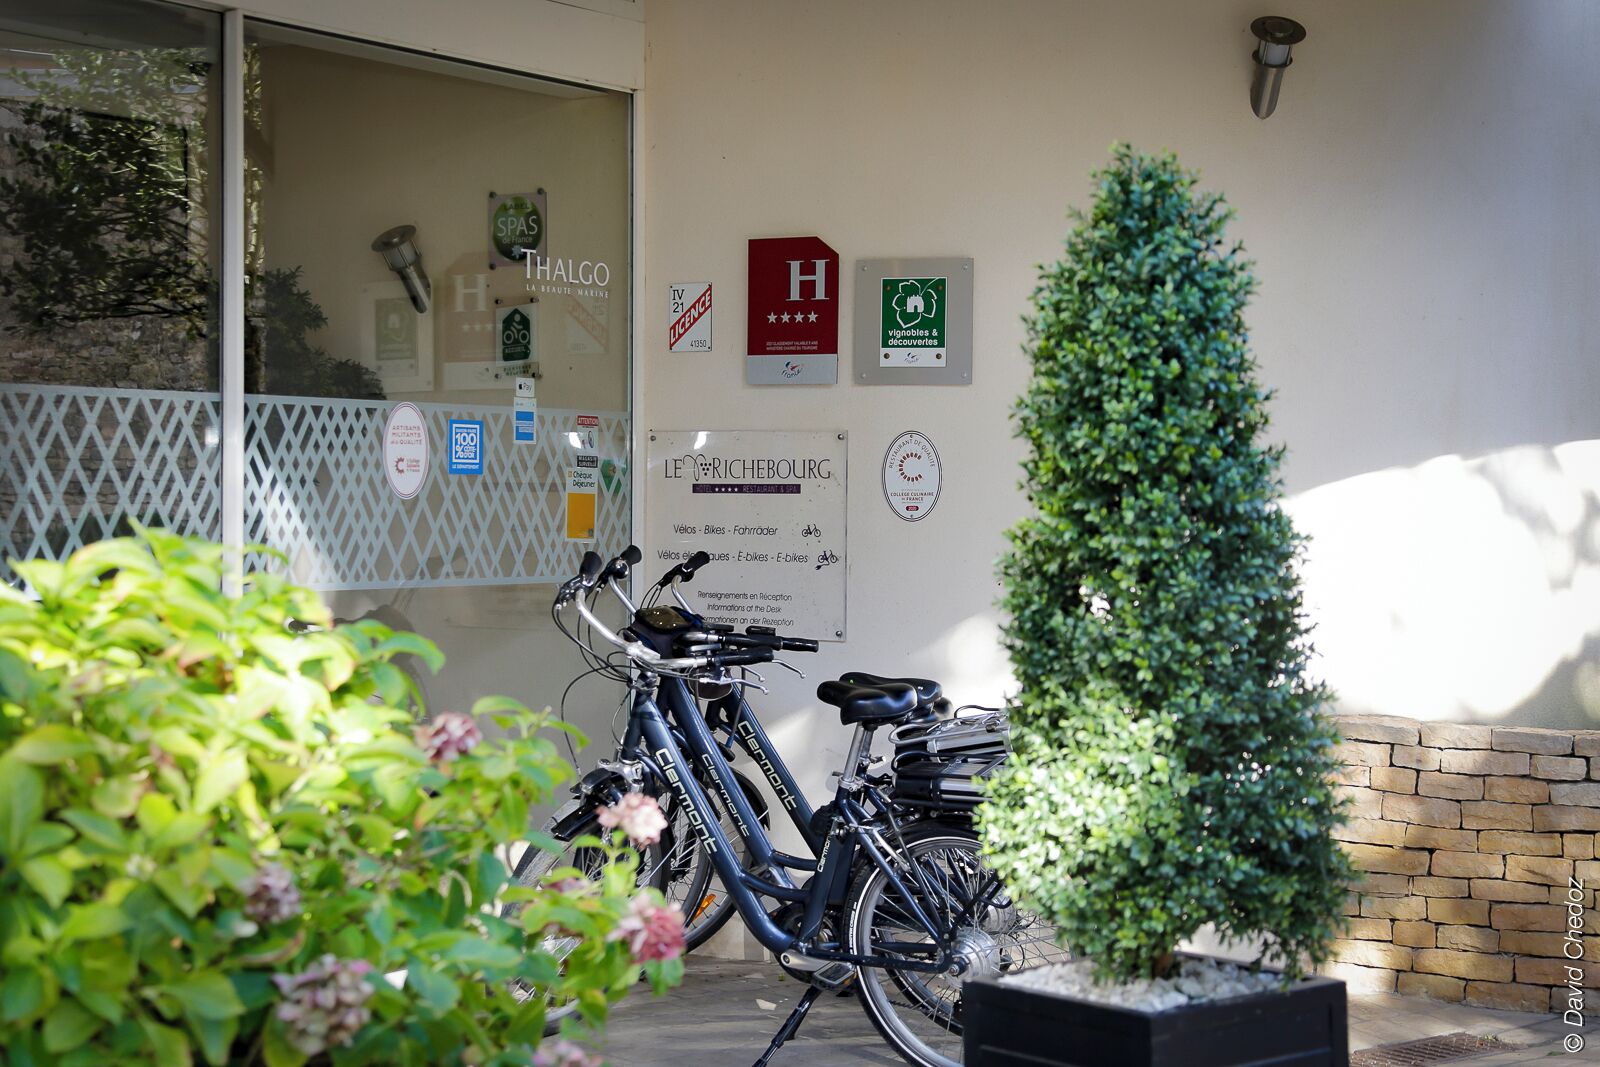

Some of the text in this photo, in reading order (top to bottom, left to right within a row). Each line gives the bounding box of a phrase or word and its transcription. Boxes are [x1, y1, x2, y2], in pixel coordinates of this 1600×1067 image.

[497, 215, 538, 236] SPAS
[521, 248, 609, 286] THALGO
[785, 259, 830, 301] H
[541, 285, 572, 295] BEAUTE
[577, 289, 609, 299] MARINE
[672, 289, 685, 300] IV
[673, 302, 684, 313] 21
[671, 289, 711, 345] LICENCE
[888, 329, 929, 338] vignobles
[888, 338, 938, 346] découvertes
[523, 382, 532, 393] Pay
[578, 417, 599, 425] ATTENTION
[455, 433, 476, 445] 100
[889, 439, 913, 469] RESTAURANT
[914, 439, 921, 447] DE
[664, 457, 831, 479] LE RICHEBOURG
[573, 470, 592, 480] Chèque
[573, 479, 595, 488] Déjeuner
[673, 524, 696, 535] Vélos
[704, 525, 725, 535] Bikes
[733, 525, 778, 536] Fahrräder
[657, 549, 680, 560] Vélos
[737, 551, 768, 562] E-bikes
[777, 552, 808, 563] E-bikes
[698, 591, 748, 601] Renseignements
[759, 592, 792, 602] Réception
[761, 617, 794, 627] Rezeption
[738, 720, 798, 811] Clermont
[655, 748, 717, 854] Clermont
[702, 754, 750, 837] Clermont
[817, 834, 832, 873] Clermon
